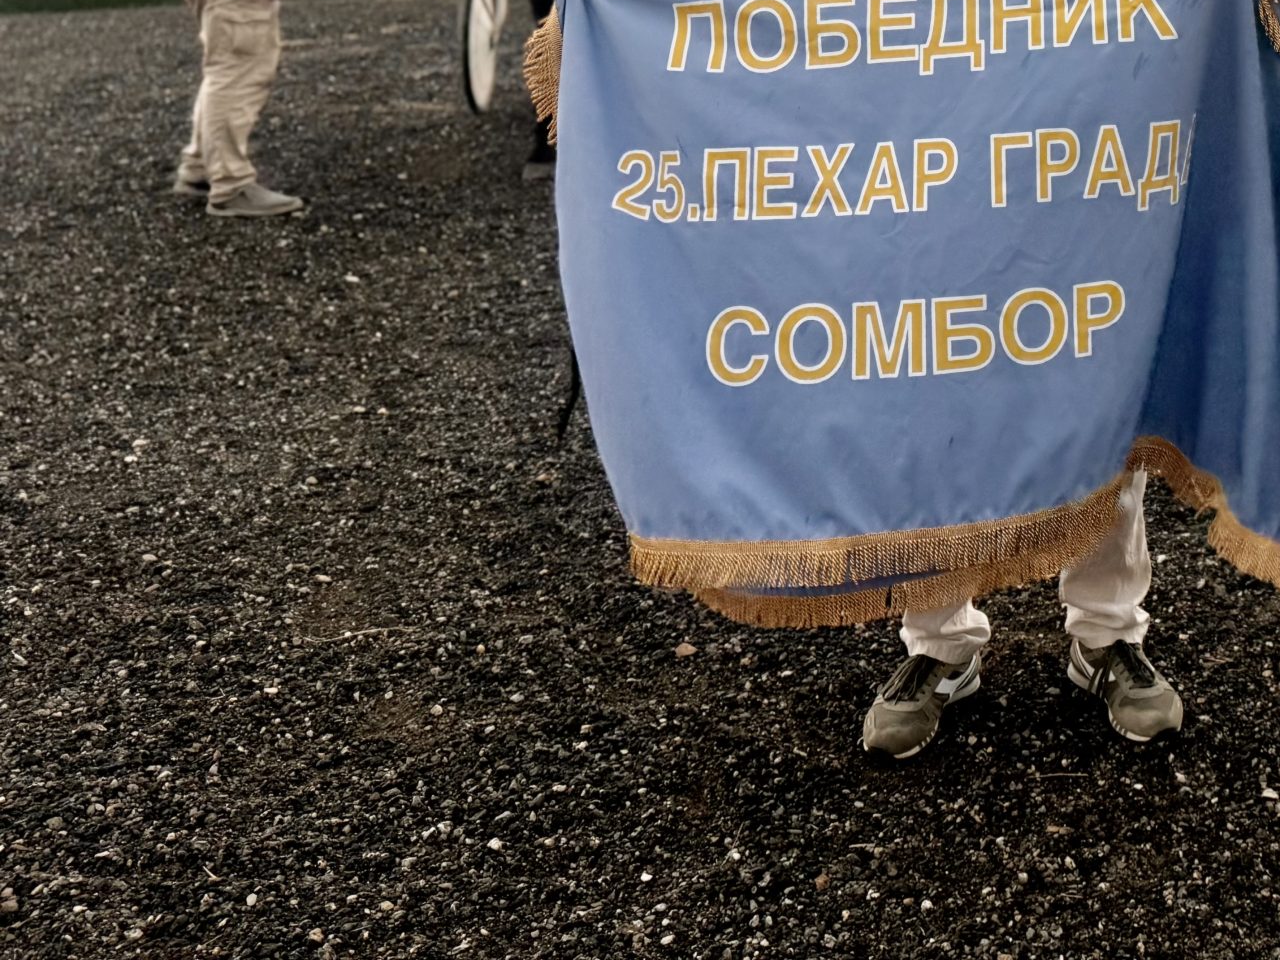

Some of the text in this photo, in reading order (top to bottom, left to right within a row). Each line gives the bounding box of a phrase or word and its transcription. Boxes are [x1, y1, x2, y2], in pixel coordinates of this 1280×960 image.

[612, 113, 1196, 223] 25.ПЕХАР ГРАД
[706, 281, 1125, 386] СОМБОР
